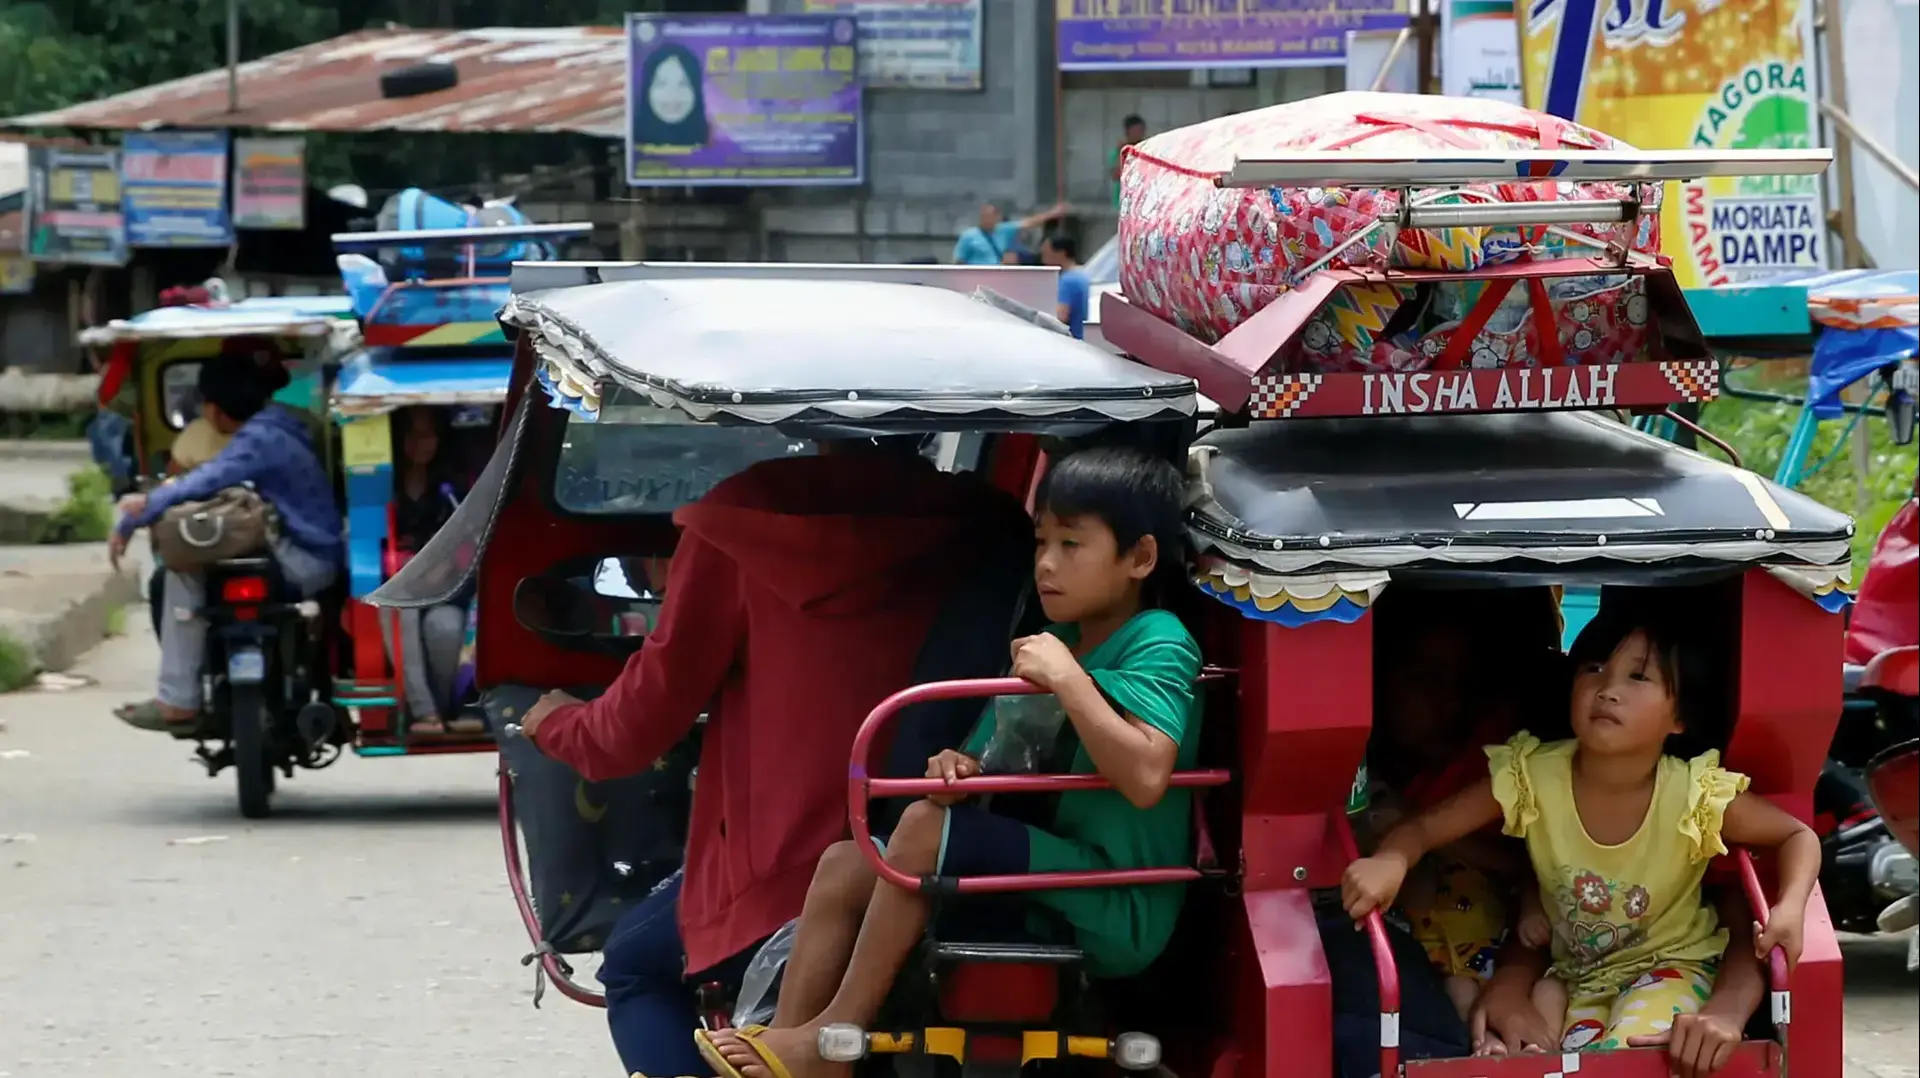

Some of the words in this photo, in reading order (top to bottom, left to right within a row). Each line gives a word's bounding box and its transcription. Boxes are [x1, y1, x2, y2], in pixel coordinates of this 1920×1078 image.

[1694, 62, 1806, 148] TAGORA
[1362, 373, 1478, 415] INSHA
[1493, 365, 1619, 408] ALLAH
